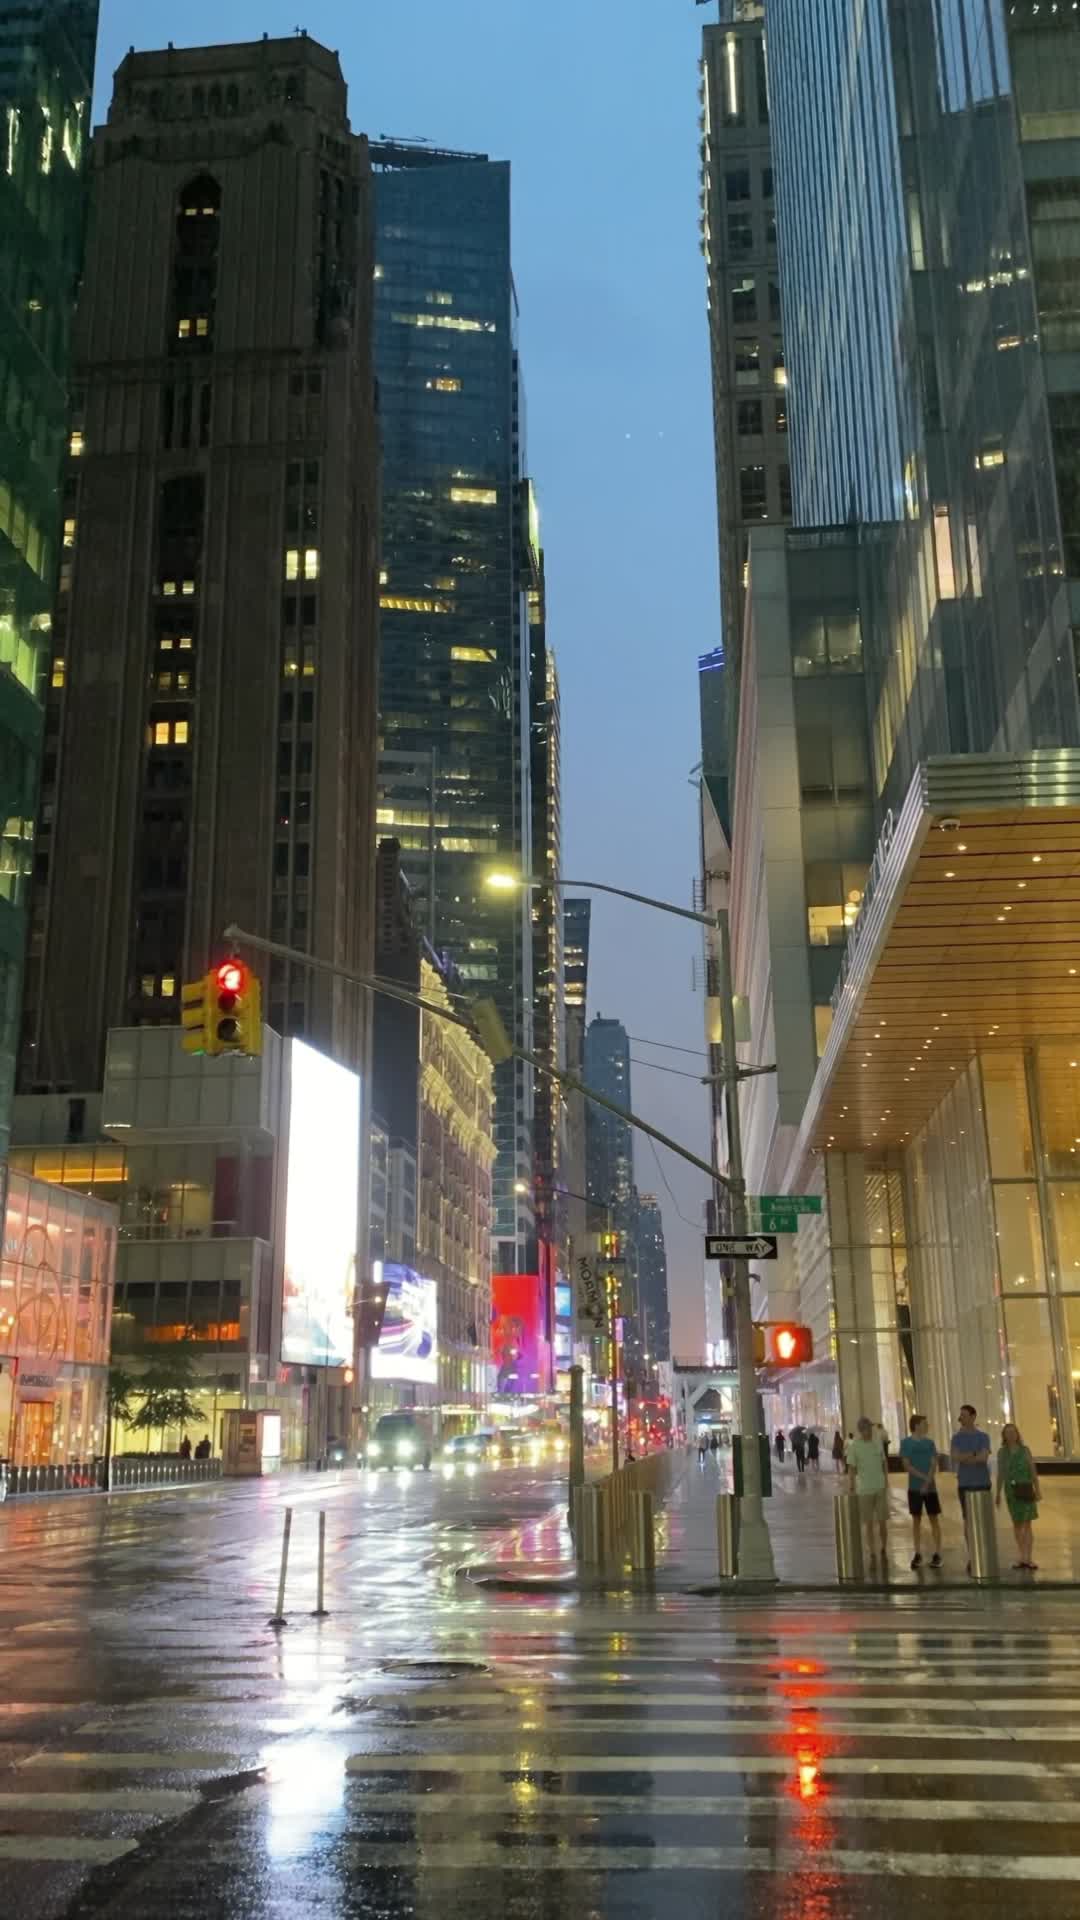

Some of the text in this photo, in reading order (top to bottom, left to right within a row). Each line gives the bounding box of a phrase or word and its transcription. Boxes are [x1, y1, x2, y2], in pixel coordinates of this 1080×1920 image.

[769, 1217, 777, 1231] 6
[715, 1243, 769, 1253] ONE WAY
